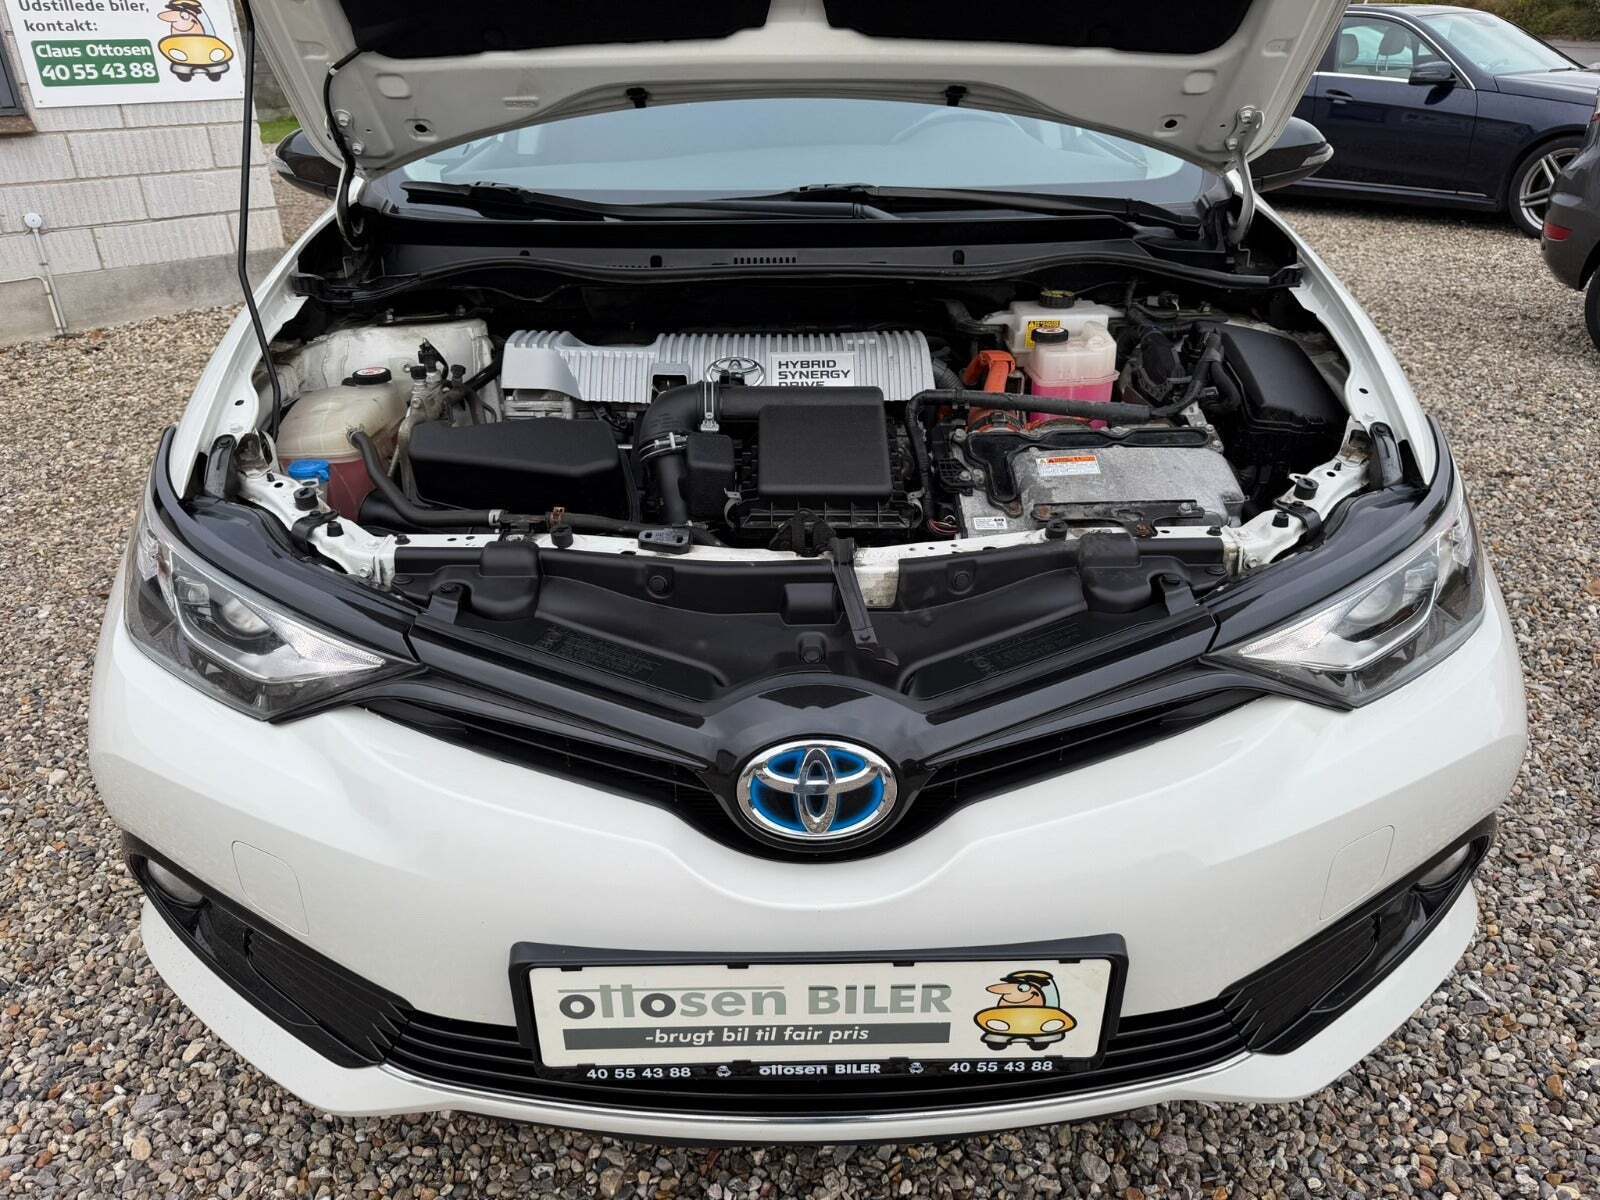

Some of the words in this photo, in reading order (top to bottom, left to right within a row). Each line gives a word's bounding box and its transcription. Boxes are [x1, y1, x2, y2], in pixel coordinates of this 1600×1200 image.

[18, 0, 105, 12] Udstillede
[109, 0, 150, 13] biler,
[23, 19, 99, 32] kontakt:
[36, 44, 82, 58] Claus
[85, 44, 152, 57] Ottosen
[41, 64, 70, 80] 40
[72, 63, 98, 80] 55
[101, 62, 127, 79] 43
[128, 62, 156, 78] 88
[778, 359, 837, 369] HYBRID
[778, 369, 851, 380] SYNERGY
[558, 984, 787, 1020] ottosen
[808, 983, 952, 1015] BILER
[645, 1028, 715, 1046] -brugt
[722, 1027, 749, 1042] bil
[755, 1026, 777, 1041] til
[783, 1026, 823, 1041] fair
[828, 1025, 870, 1044] pris
[586, 1068, 609, 1080] 40
[614, 1067, 636, 1080] 55
[641, 1067, 664, 1079] 43
[669, 1066, 692, 1079] 88
[759, 1063, 828, 1076] ottosen
[834, 1062, 881, 1075] BILER
[949, 1061, 971, 1073] 40
[976, 1061, 998, 1072] 55
[1003, 1061, 1025, 1072] 43
[1030, 1060, 1053, 1072] 88
